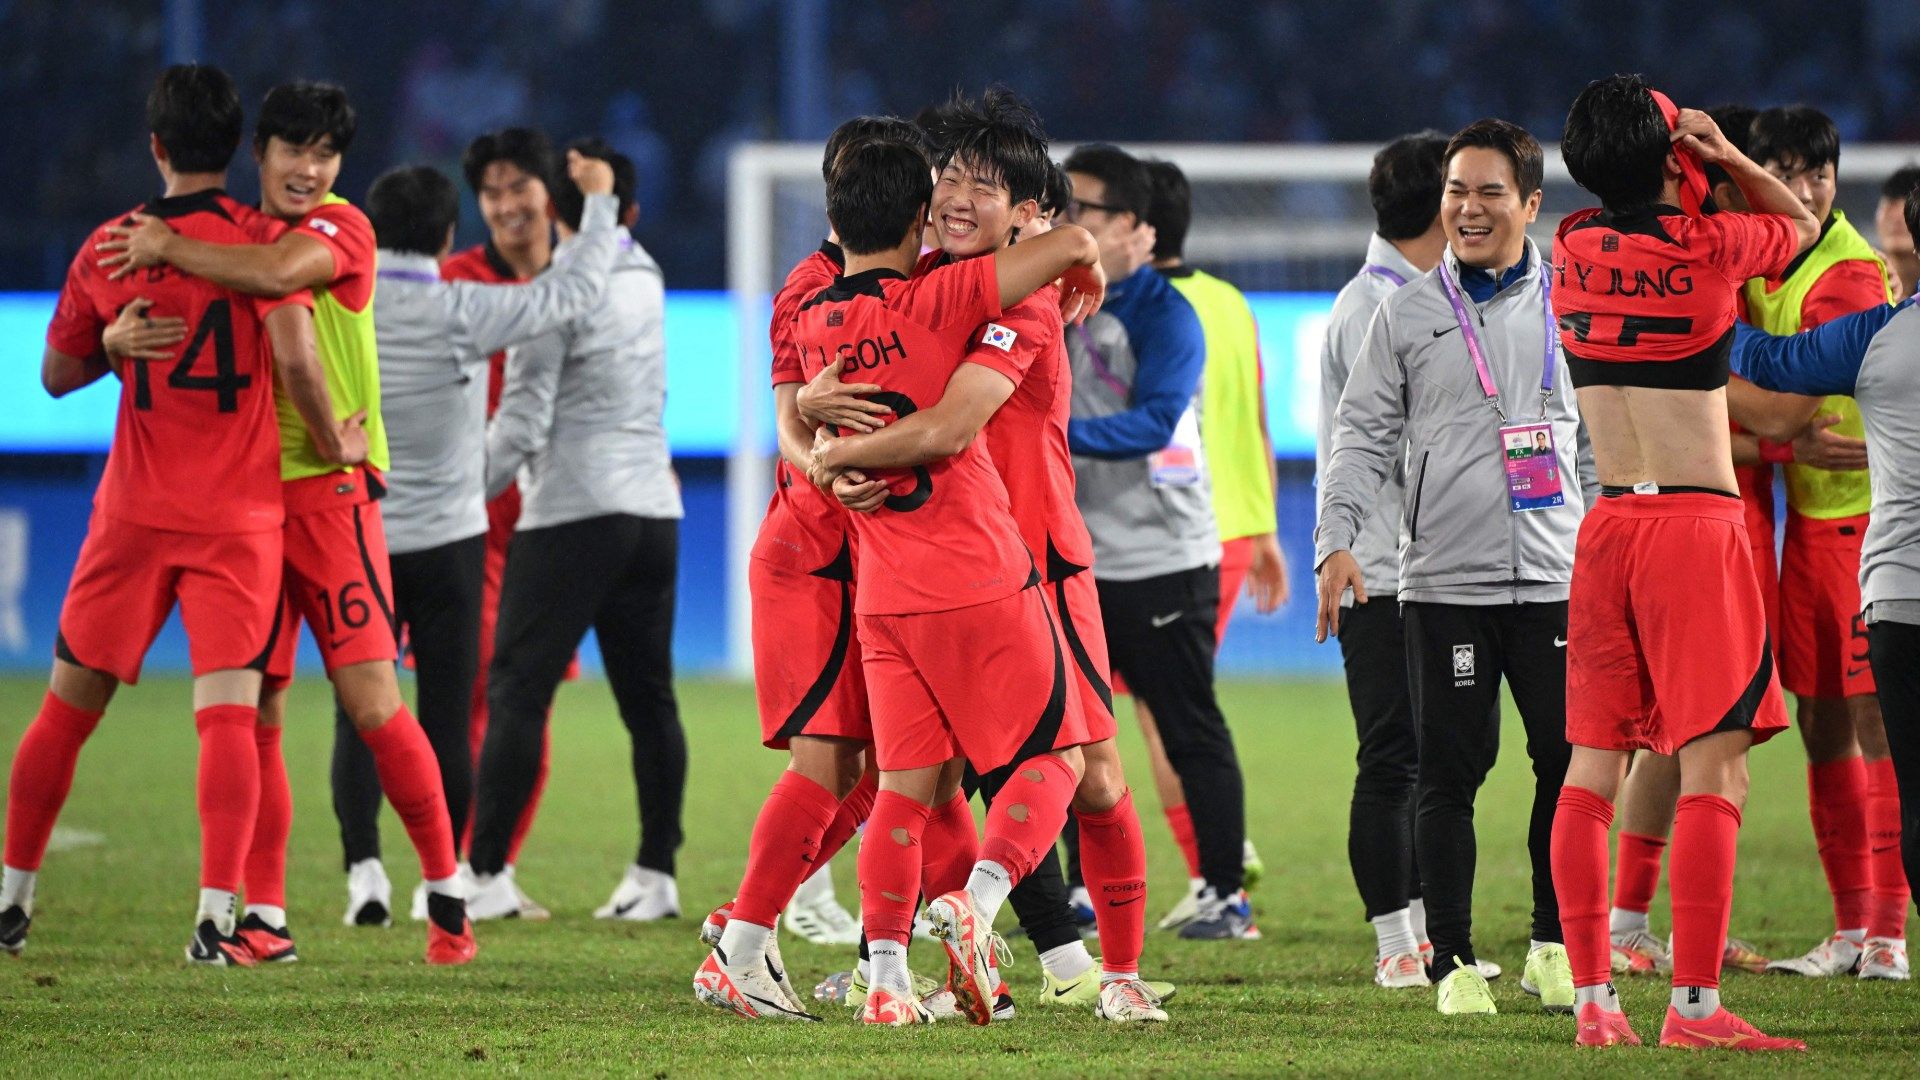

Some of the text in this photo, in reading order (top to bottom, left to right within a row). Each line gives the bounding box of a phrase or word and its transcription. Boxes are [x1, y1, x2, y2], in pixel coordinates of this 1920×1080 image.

[1574, 261, 1593, 292] Y
[1605, 264, 1693, 298] JUNG
[116, 298, 252, 413] 14
[837, 330, 907, 373] GOH
[1552, 496, 1562, 504] 2R
[317, 582, 370, 634] 16
[1851, 613, 1870, 662] 5
[1454, 679, 1475, 687] KOREA
[975, 867, 1001, 881] MAKER
[1103, 882, 1146, 892] KOREA
